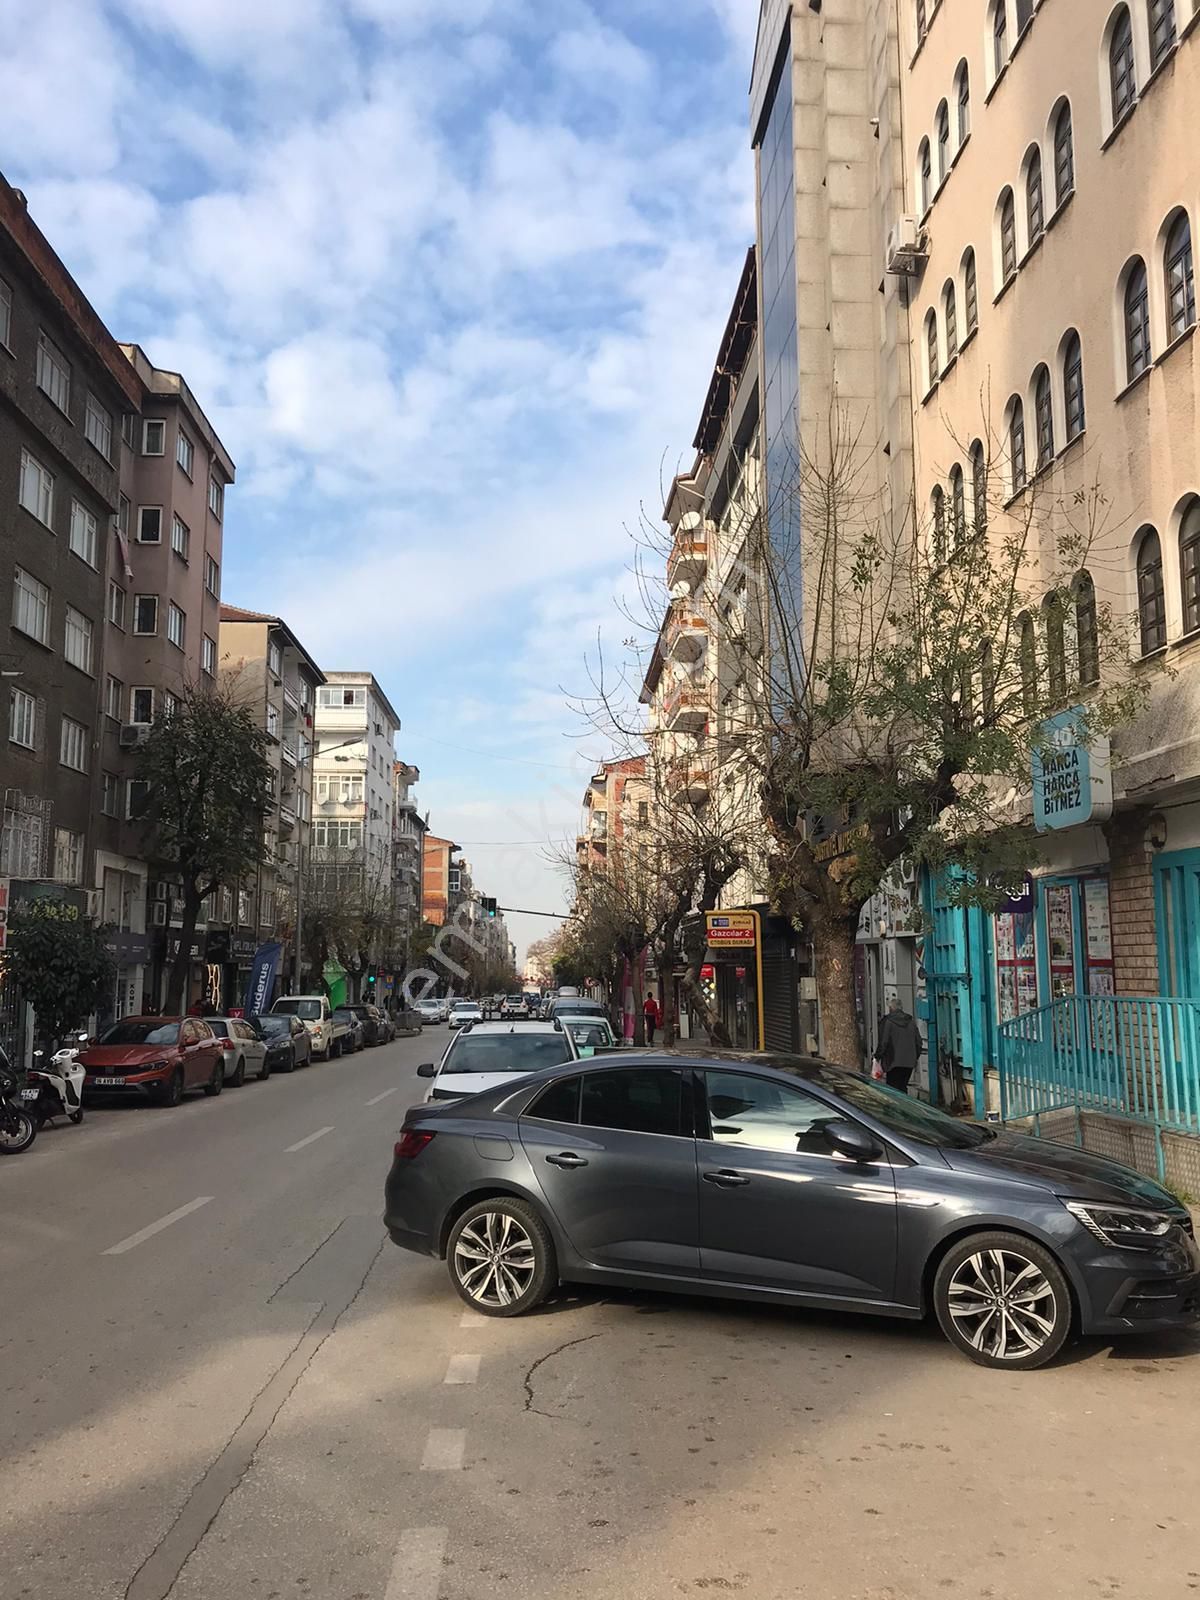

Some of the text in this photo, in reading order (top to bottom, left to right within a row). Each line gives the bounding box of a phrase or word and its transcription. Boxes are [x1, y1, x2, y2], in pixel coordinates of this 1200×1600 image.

[1043, 770, 1081, 796] HARCA
[710, 929, 751, 937] Gazcılar 2
[250, 962, 270, 1016] Buderus
